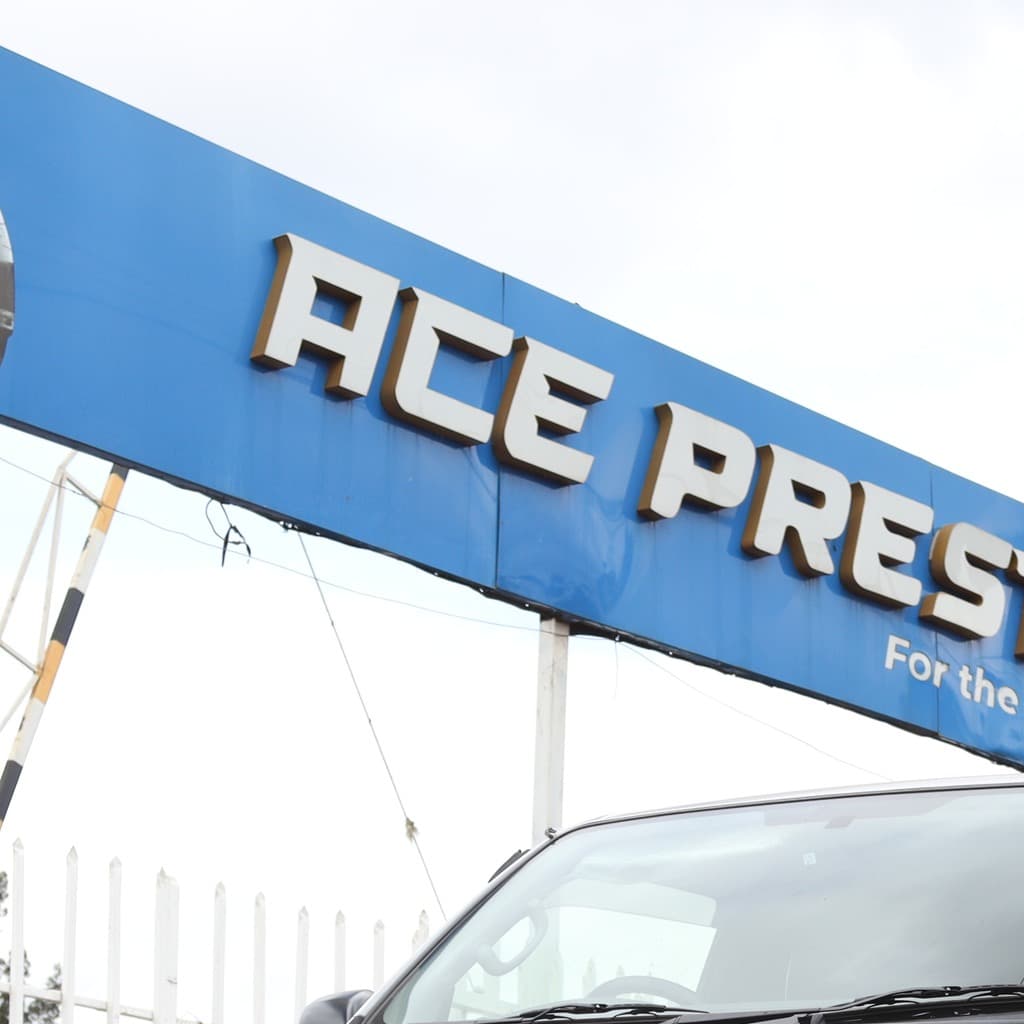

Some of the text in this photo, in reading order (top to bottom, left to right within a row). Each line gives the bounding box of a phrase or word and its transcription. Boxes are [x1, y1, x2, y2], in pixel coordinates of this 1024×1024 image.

[250, 233, 615, 487] ACE
[884, 634, 950, 689] For
[958, 663, 1020, 716] the
